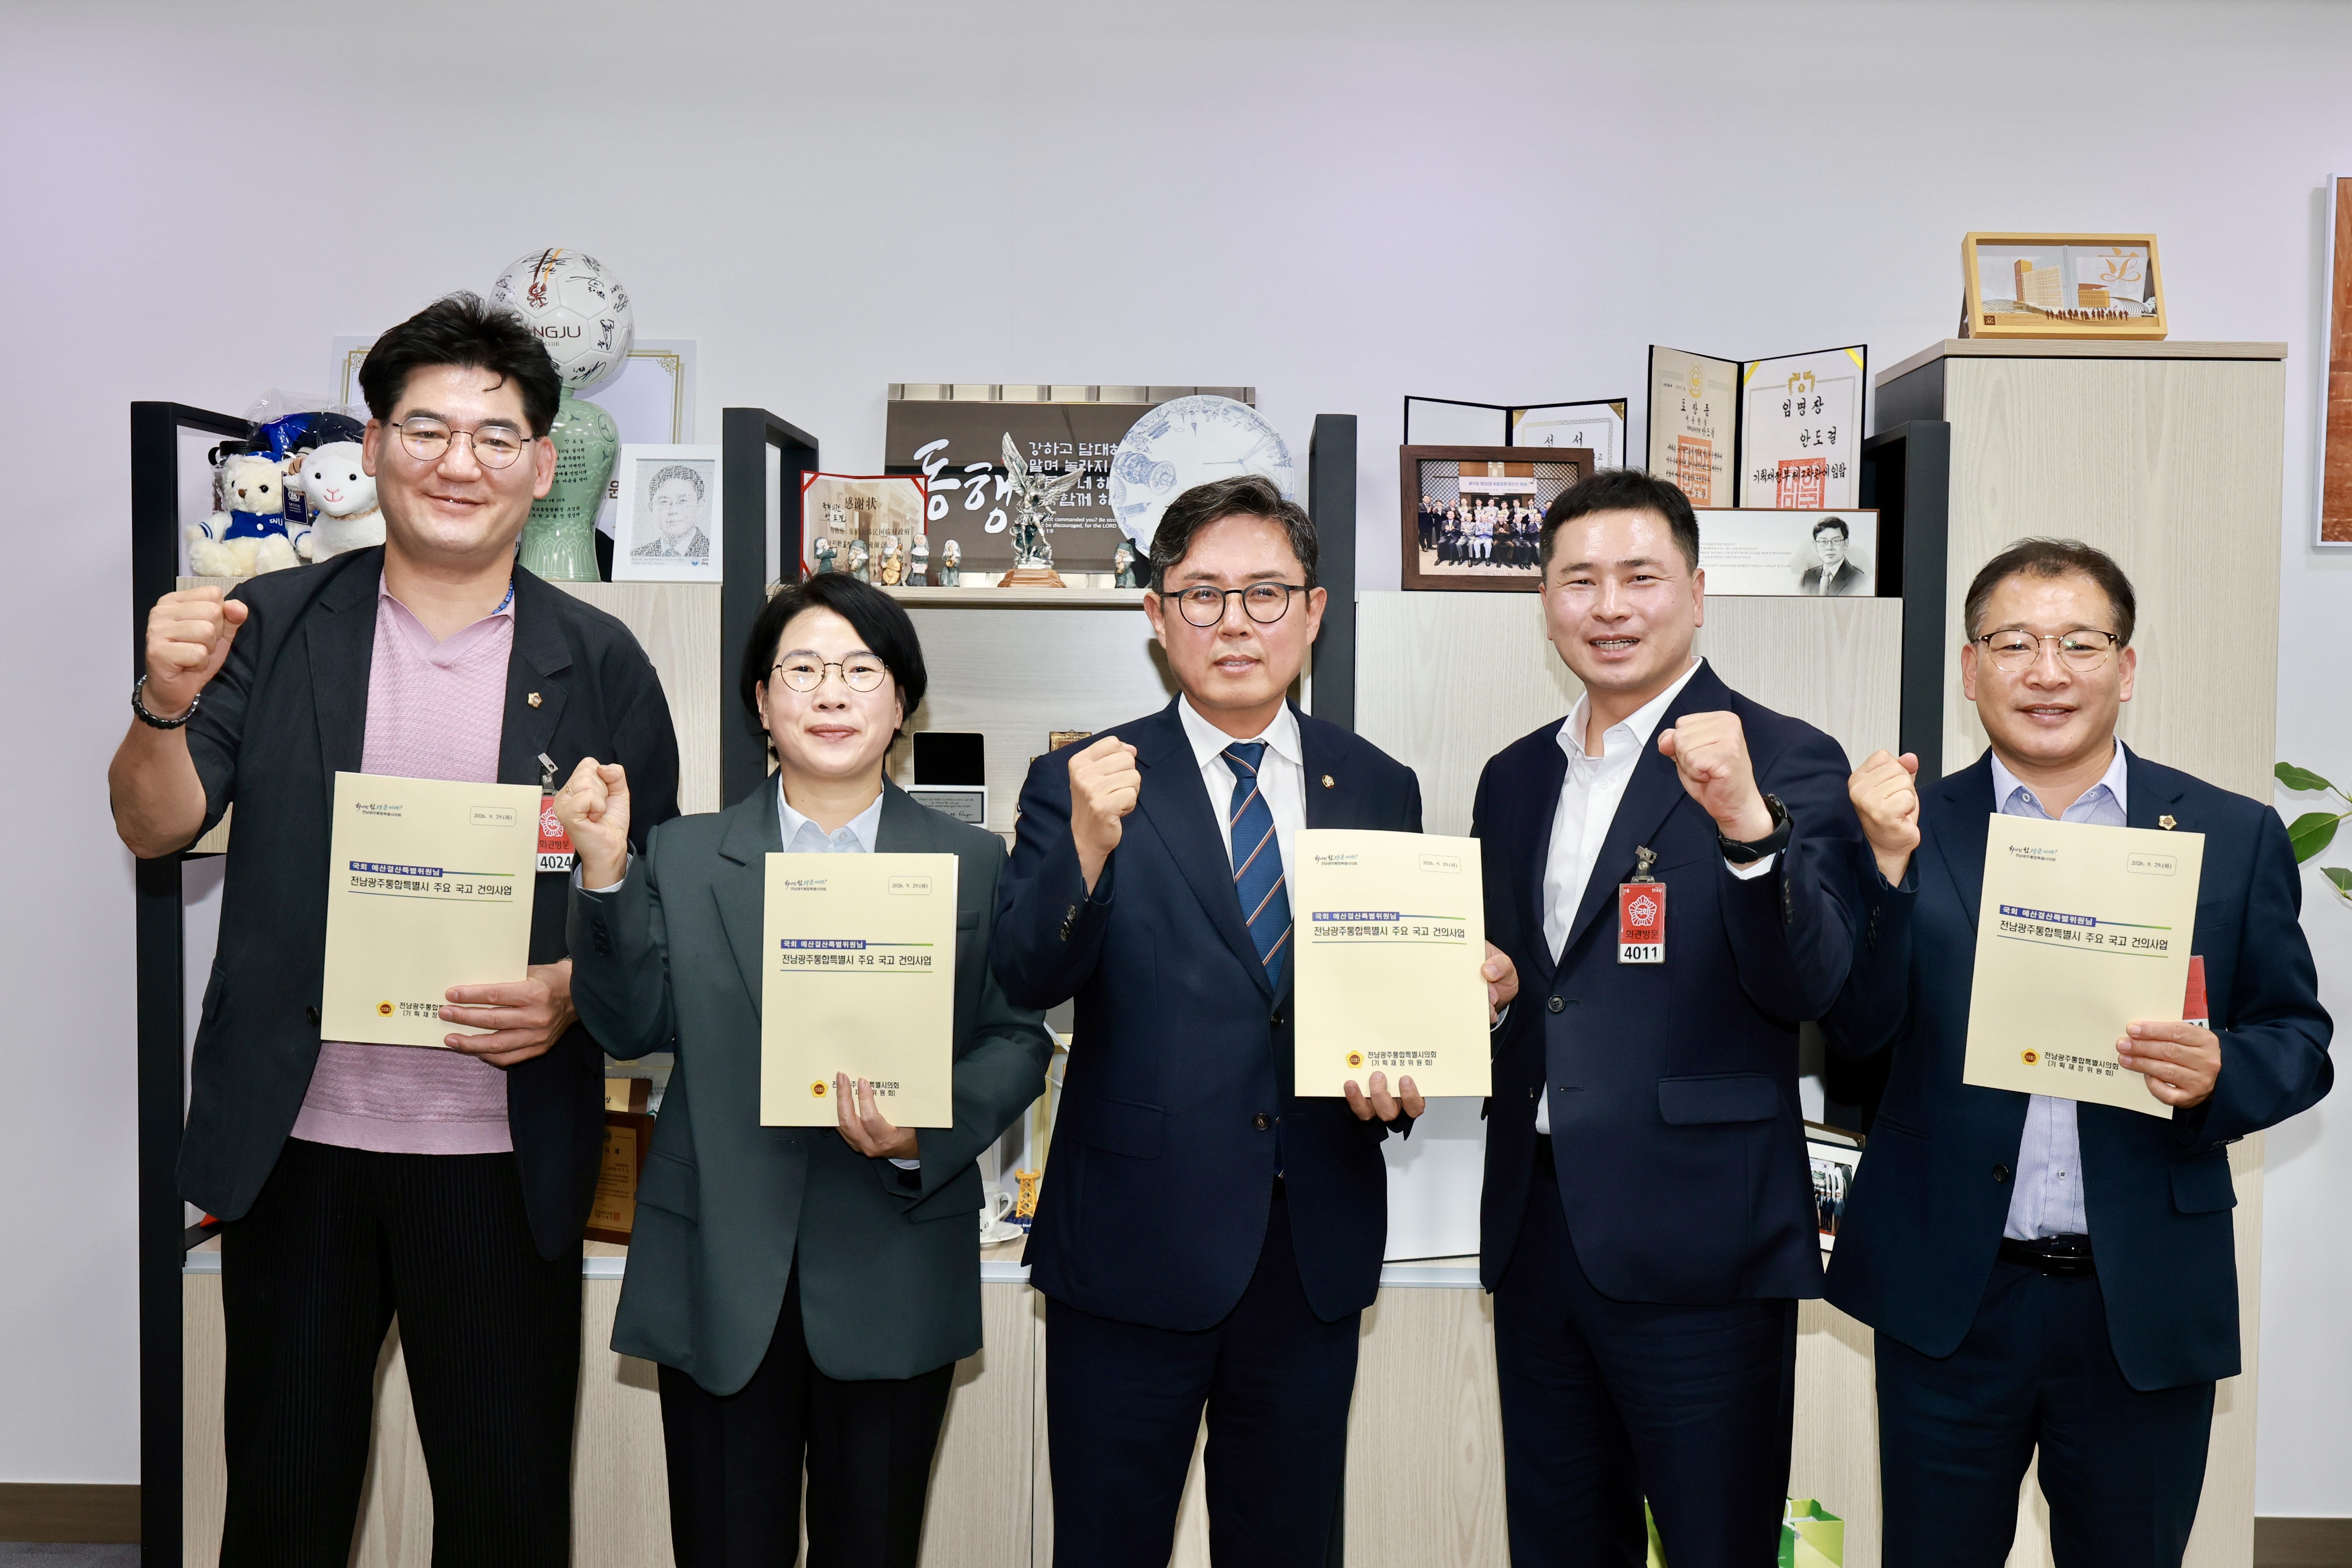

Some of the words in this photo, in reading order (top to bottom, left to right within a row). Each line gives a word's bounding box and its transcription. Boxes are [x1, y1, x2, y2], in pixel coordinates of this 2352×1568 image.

[533, 326, 581, 338] NGJU
[1782, 396, 1824, 417] 임명장
[1800, 426, 1837, 447] 안도걸
[1029, 442, 1072, 456] 강하고
[1029, 459, 1058, 472] 말며
[1065, 459, 1107, 472] 놀라지
[913, 439, 1013, 534] 동행
[845, 496, 877, 510] 感谢状
[1060, 492, 1091, 507] 함께
[269, 518, 283, 526] SNU
[540, 840, 570, 849] 회관방문
[540, 856, 570, 869] 4024
[372, 864, 439, 876] 예산결산특별위원님
[351, 876, 429, 892] 전남광주통합특별시
[433, 882, 450, 892] 주요
[455, 884, 473, 894] 국고
[478, 885, 512, 895] 건의사업
[1636, 908, 1648, 916] 국회
[2003, 907, 2017, 915] 국회
[2022, 908, 2093, 926] 예산결산특별위원님
[1314, 926, 1387, 936] 전남광주통합특별시
[1392, 927, 1408, 936] 주요
[1413, 927, 1428, 936] 국고
[1433, 927, 1465, 938] 건의사업
[1626, 930, 1658, 939] 회관방문
[2000, 920, 2081, 941] 전남광주통합특별시
[2085, 933, 2104, 944] 주요
[2109, 935, 2126, 946] 국고
[2131, 937, 2168, 950] 건의사업
[1624, 946, 1657, 959] 4011
[782, 954, 853, 965] 전남광주통합특별시
[858, 955, 874, 965] 주요
[879, 956, 894, 965] 국고
[899, 956, 931, 965] 건의사업
[2044, 1051, 2119, 1070] 전남광주통합특별시의회
